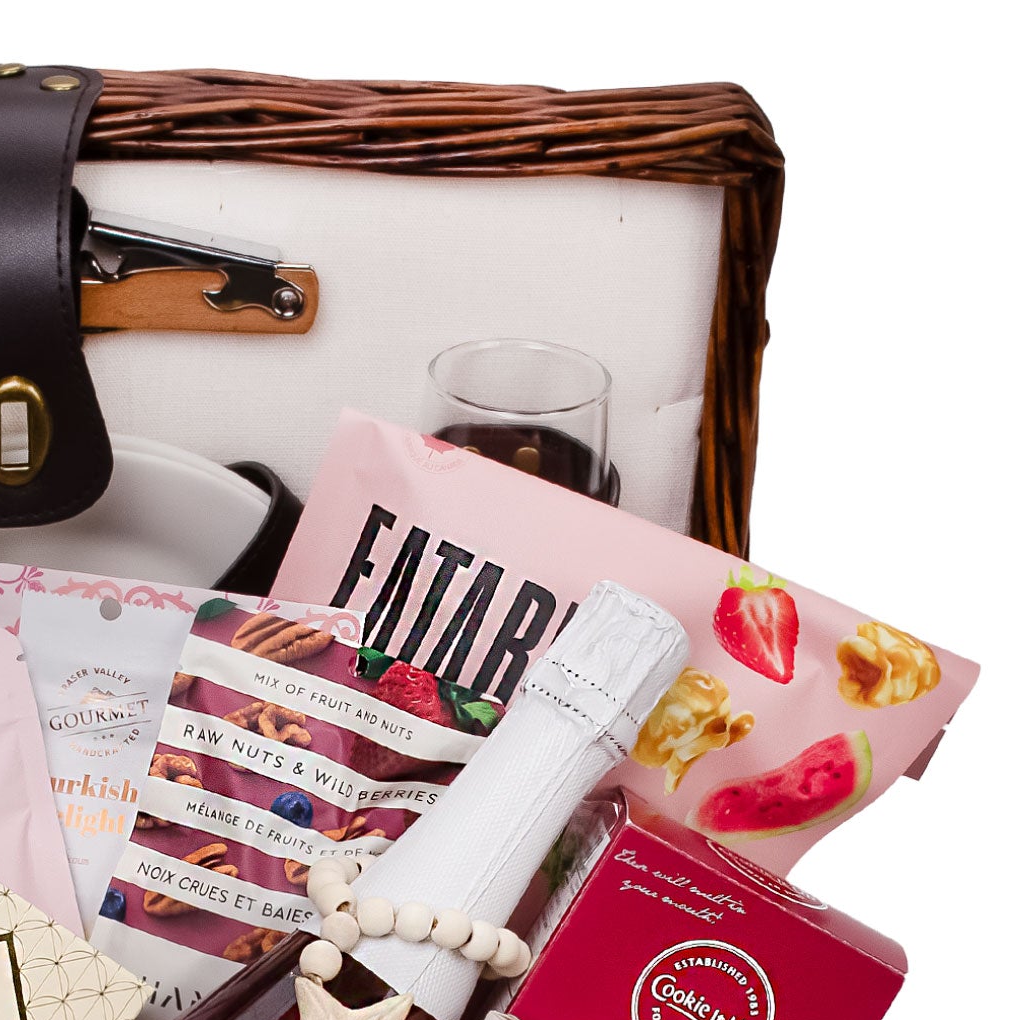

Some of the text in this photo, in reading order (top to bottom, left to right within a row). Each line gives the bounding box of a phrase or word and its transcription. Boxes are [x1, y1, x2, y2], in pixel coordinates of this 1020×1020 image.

[94, 667, 131, 685] VALLEY
[49, 699, 149, 731] GOURMET
[254, 672, 413, 741] MIX OF FRUIT AND NUTS
[183, 724, 439, 805] RAW NUTS & WILD BERRIES
[185, 798, 240, 827] MÉLANGE
[244, 819, 264, 836] DE
[267, 829, 314, 856] FRUITS
[137, 861, 176, 885] NOIX
[178, 875, 229, 904] CRUES
[234, 894, 257, 912] ET
[651, 974, 711, 1019] Cookie
[673, 957, 760, 1016] ESTABLISHED 1983
